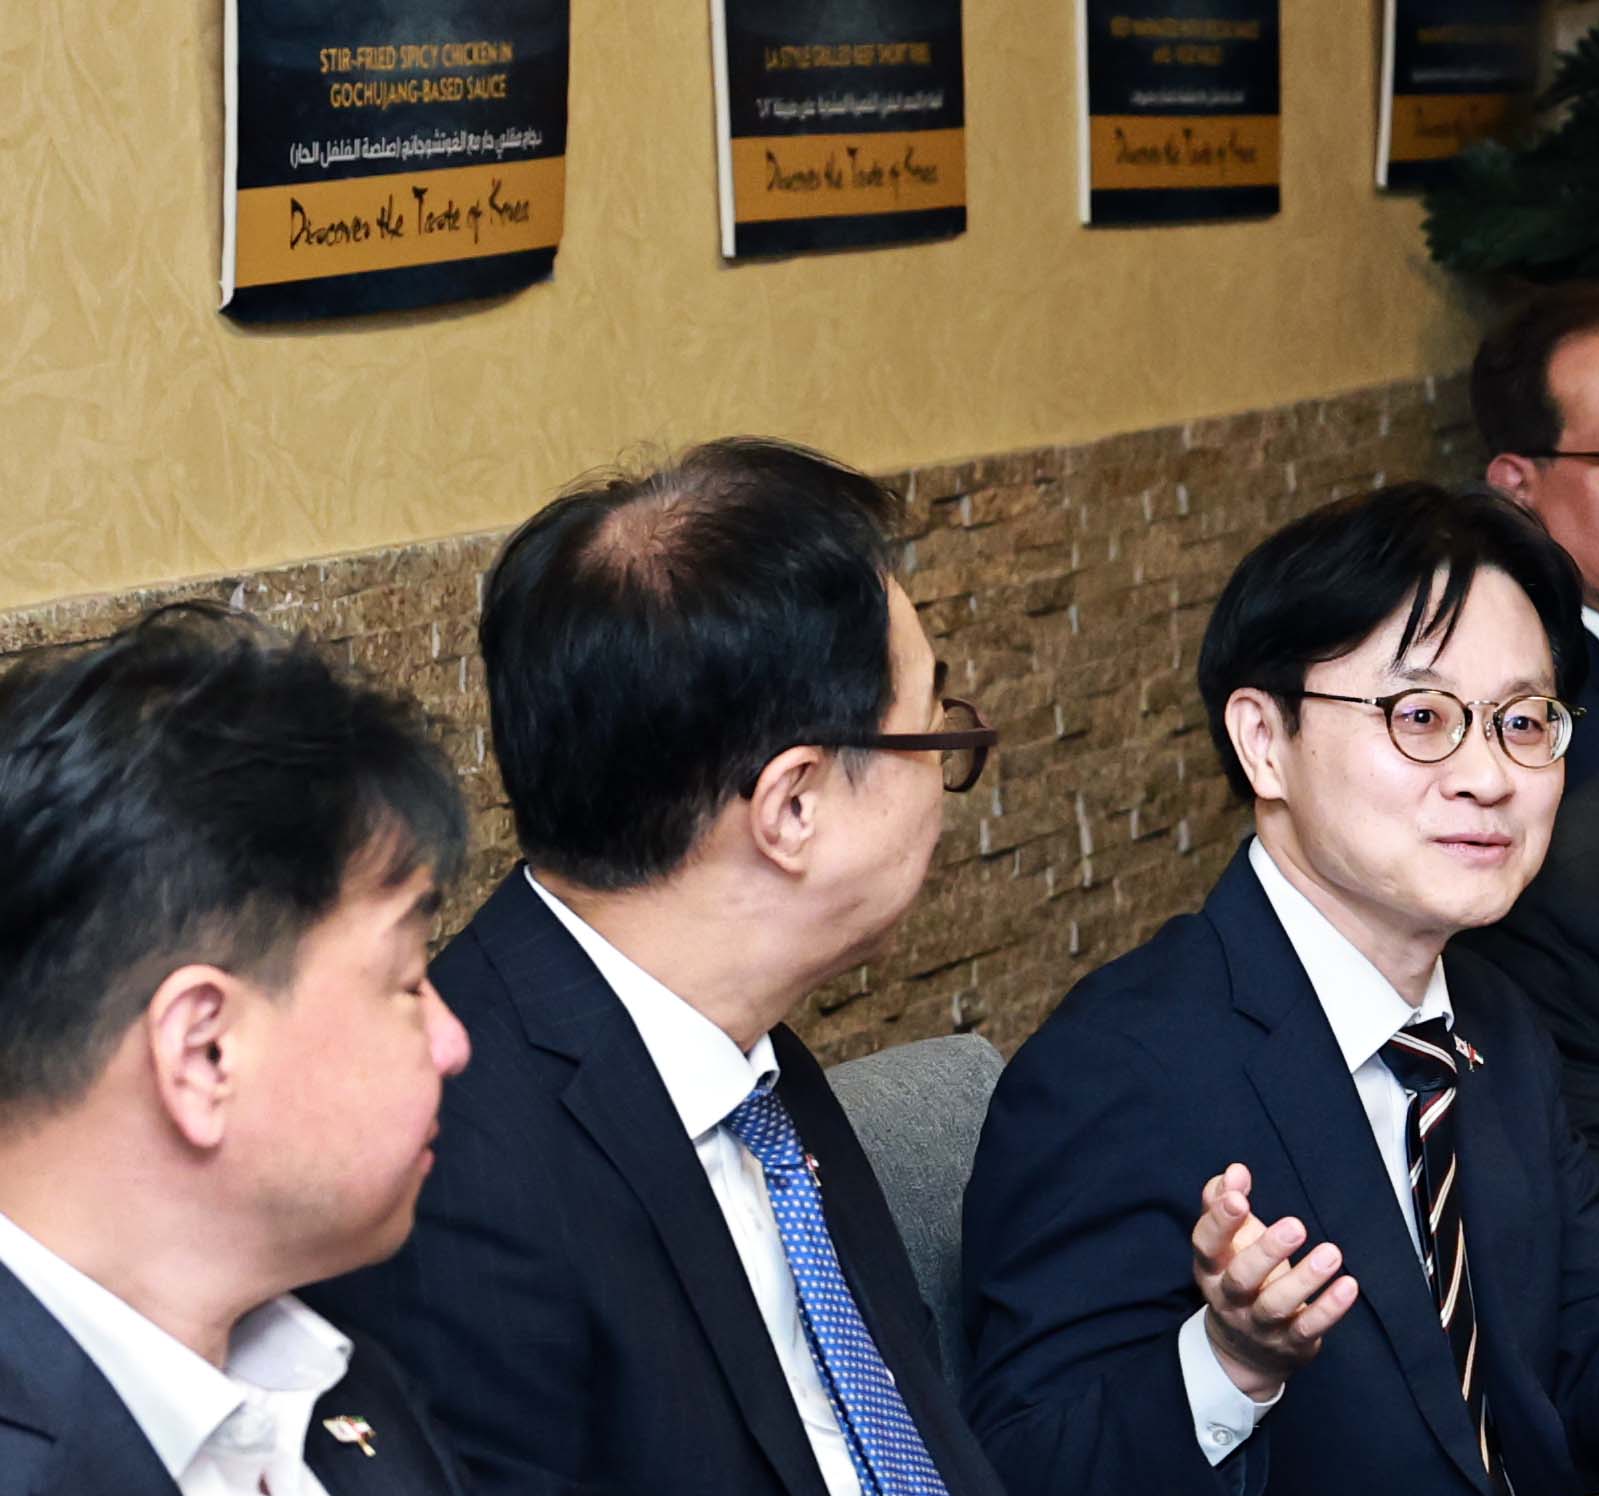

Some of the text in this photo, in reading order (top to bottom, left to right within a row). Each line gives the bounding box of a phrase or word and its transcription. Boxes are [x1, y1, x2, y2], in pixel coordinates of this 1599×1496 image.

[320, 44, 395, 73] STIR-FRIED
[399, 43, 438, 69] SPICY
[441, 41, 496, 67] CHICKEN
[331, 74, 507, 111] GOCHUJANG-BASED SAUCE
[376, 194, 404, 238] the
